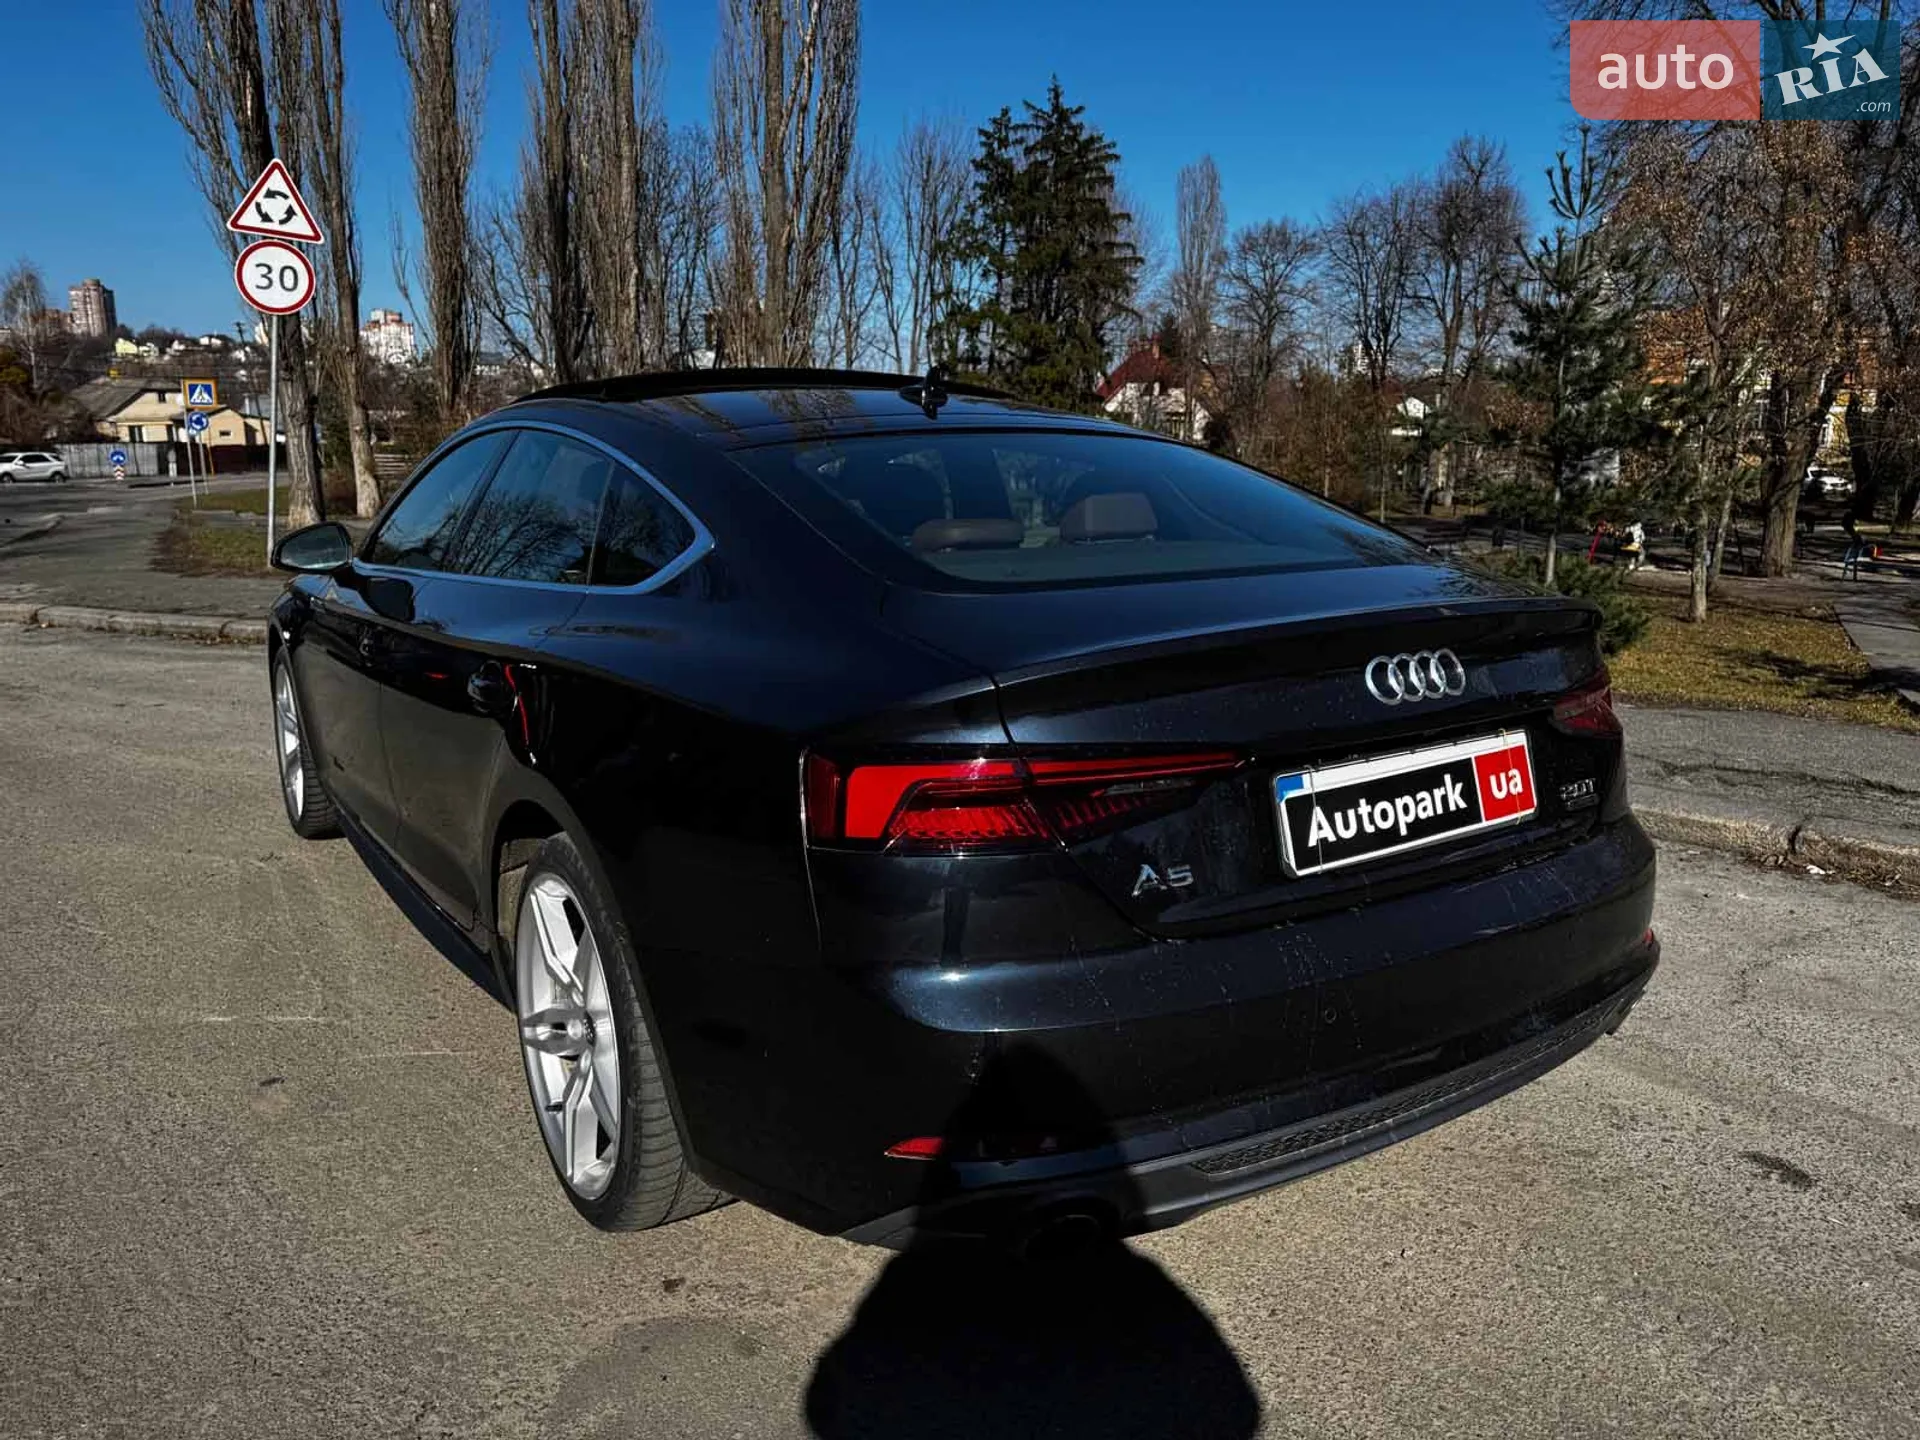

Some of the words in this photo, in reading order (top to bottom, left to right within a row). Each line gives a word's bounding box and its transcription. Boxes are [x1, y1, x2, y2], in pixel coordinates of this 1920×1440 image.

[255, 263, 299, 292] 30
[1308, 774, 1467, 847] Autopark
[1489, 768, 1523, 799] ua
[1131, 864, 1194, 897] A5
